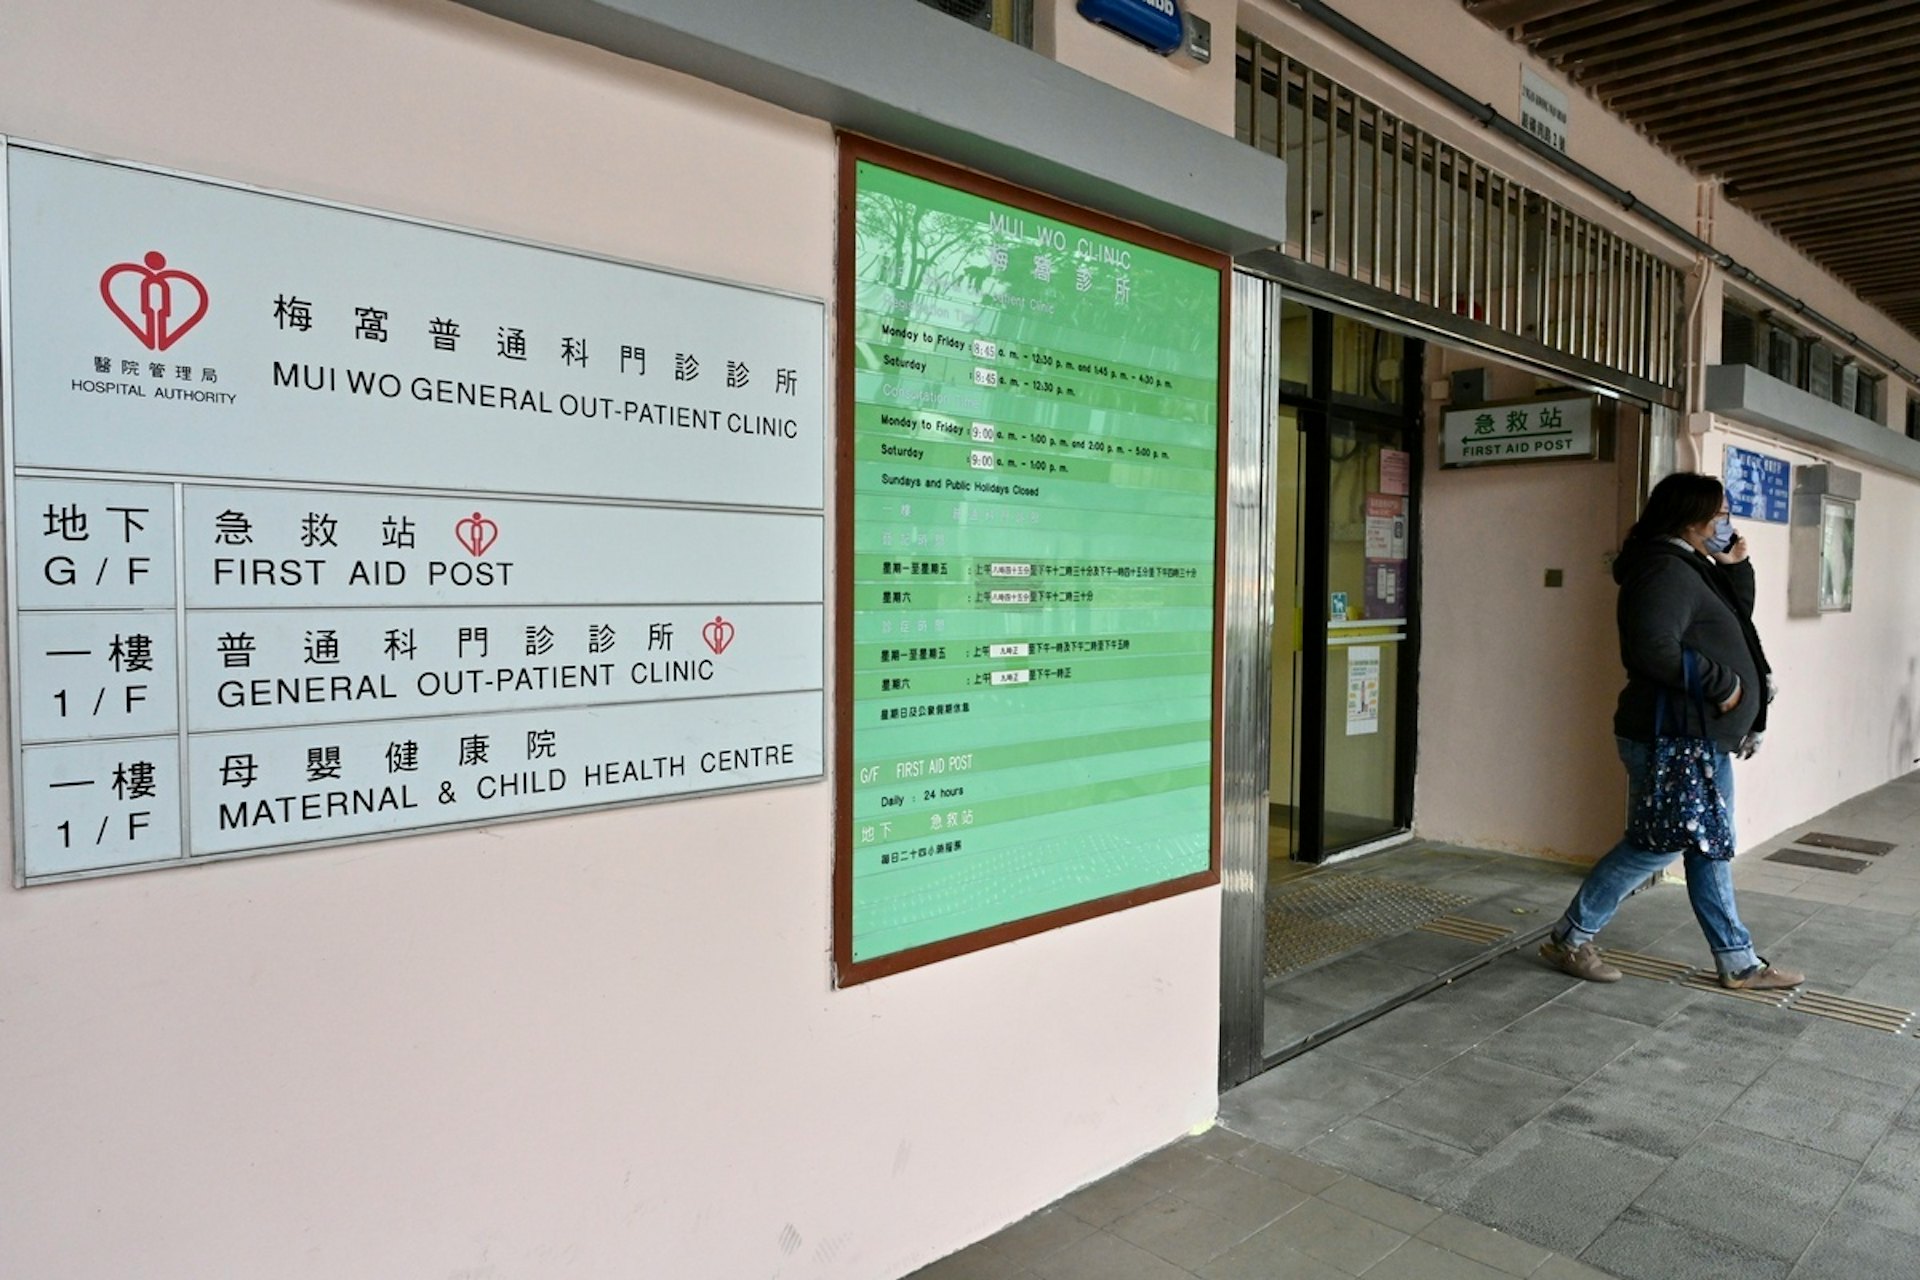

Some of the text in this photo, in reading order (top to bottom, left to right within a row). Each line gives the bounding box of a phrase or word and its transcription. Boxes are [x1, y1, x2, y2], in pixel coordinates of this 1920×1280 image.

[989, 210, 1131, 271] MUI WO CLINIC
[274, 294, 798, 396] 梅窩普通科門診診所
[882, 325, 918, 343] Monday
[923, 331, 933, 344] to
[937, 334, 965, 351] Friday
[973, 342, 995, 358] 8:45
[93, 355, 218, 384] 醫院管理局
[884, 355, 926, 373] Saturday
[975, 370, 997, 386] 8:45
[71, 379, 237, 405] HOSPITAL AUTHORITY
[273, 361, 797, 439] MUI WO GENERAL OUT-PATIENT CLINIC
[881, 414, 917, 431] Monday
[922, 420, 932, 431] to
[936, 421, 964, 436] Friday
[972, 426, 993, 439] 9:00
[1475, 406, 1562, 434] 急救站
[881, 444, 924, 460] Saturday
[972, 454, 993, 467] 9:00
[1463, 439, 1572, 456] FIRST AID POST
[881, 473, 1039, 497] Sundays and Public Holidays Closed
[42, 503, 150, 543] 地下
[214, 509, 416, 550] 急救站
[214, 558, 514, 586] FIRST AID POST
[45, 633, 153, 673] 一樓
[217, 622, 674, 668] 普通科門診診所
[217, 659, 714, 708] GENERAL OUT-PATIENT CLINIC
[219, 729, 557, 788] 母嬰健康院
[860, 754, 972, 783] G/F FIRST AID POST
[49, 760, 156, 801] 一樓
[218, 743, 794, 830] MATERNAL & CHILD HEALTH CENTRE
[881, 795, 904, 807] Daily
[924, 790, 936, 800] 24
[940, 787, 963, 797] hours
